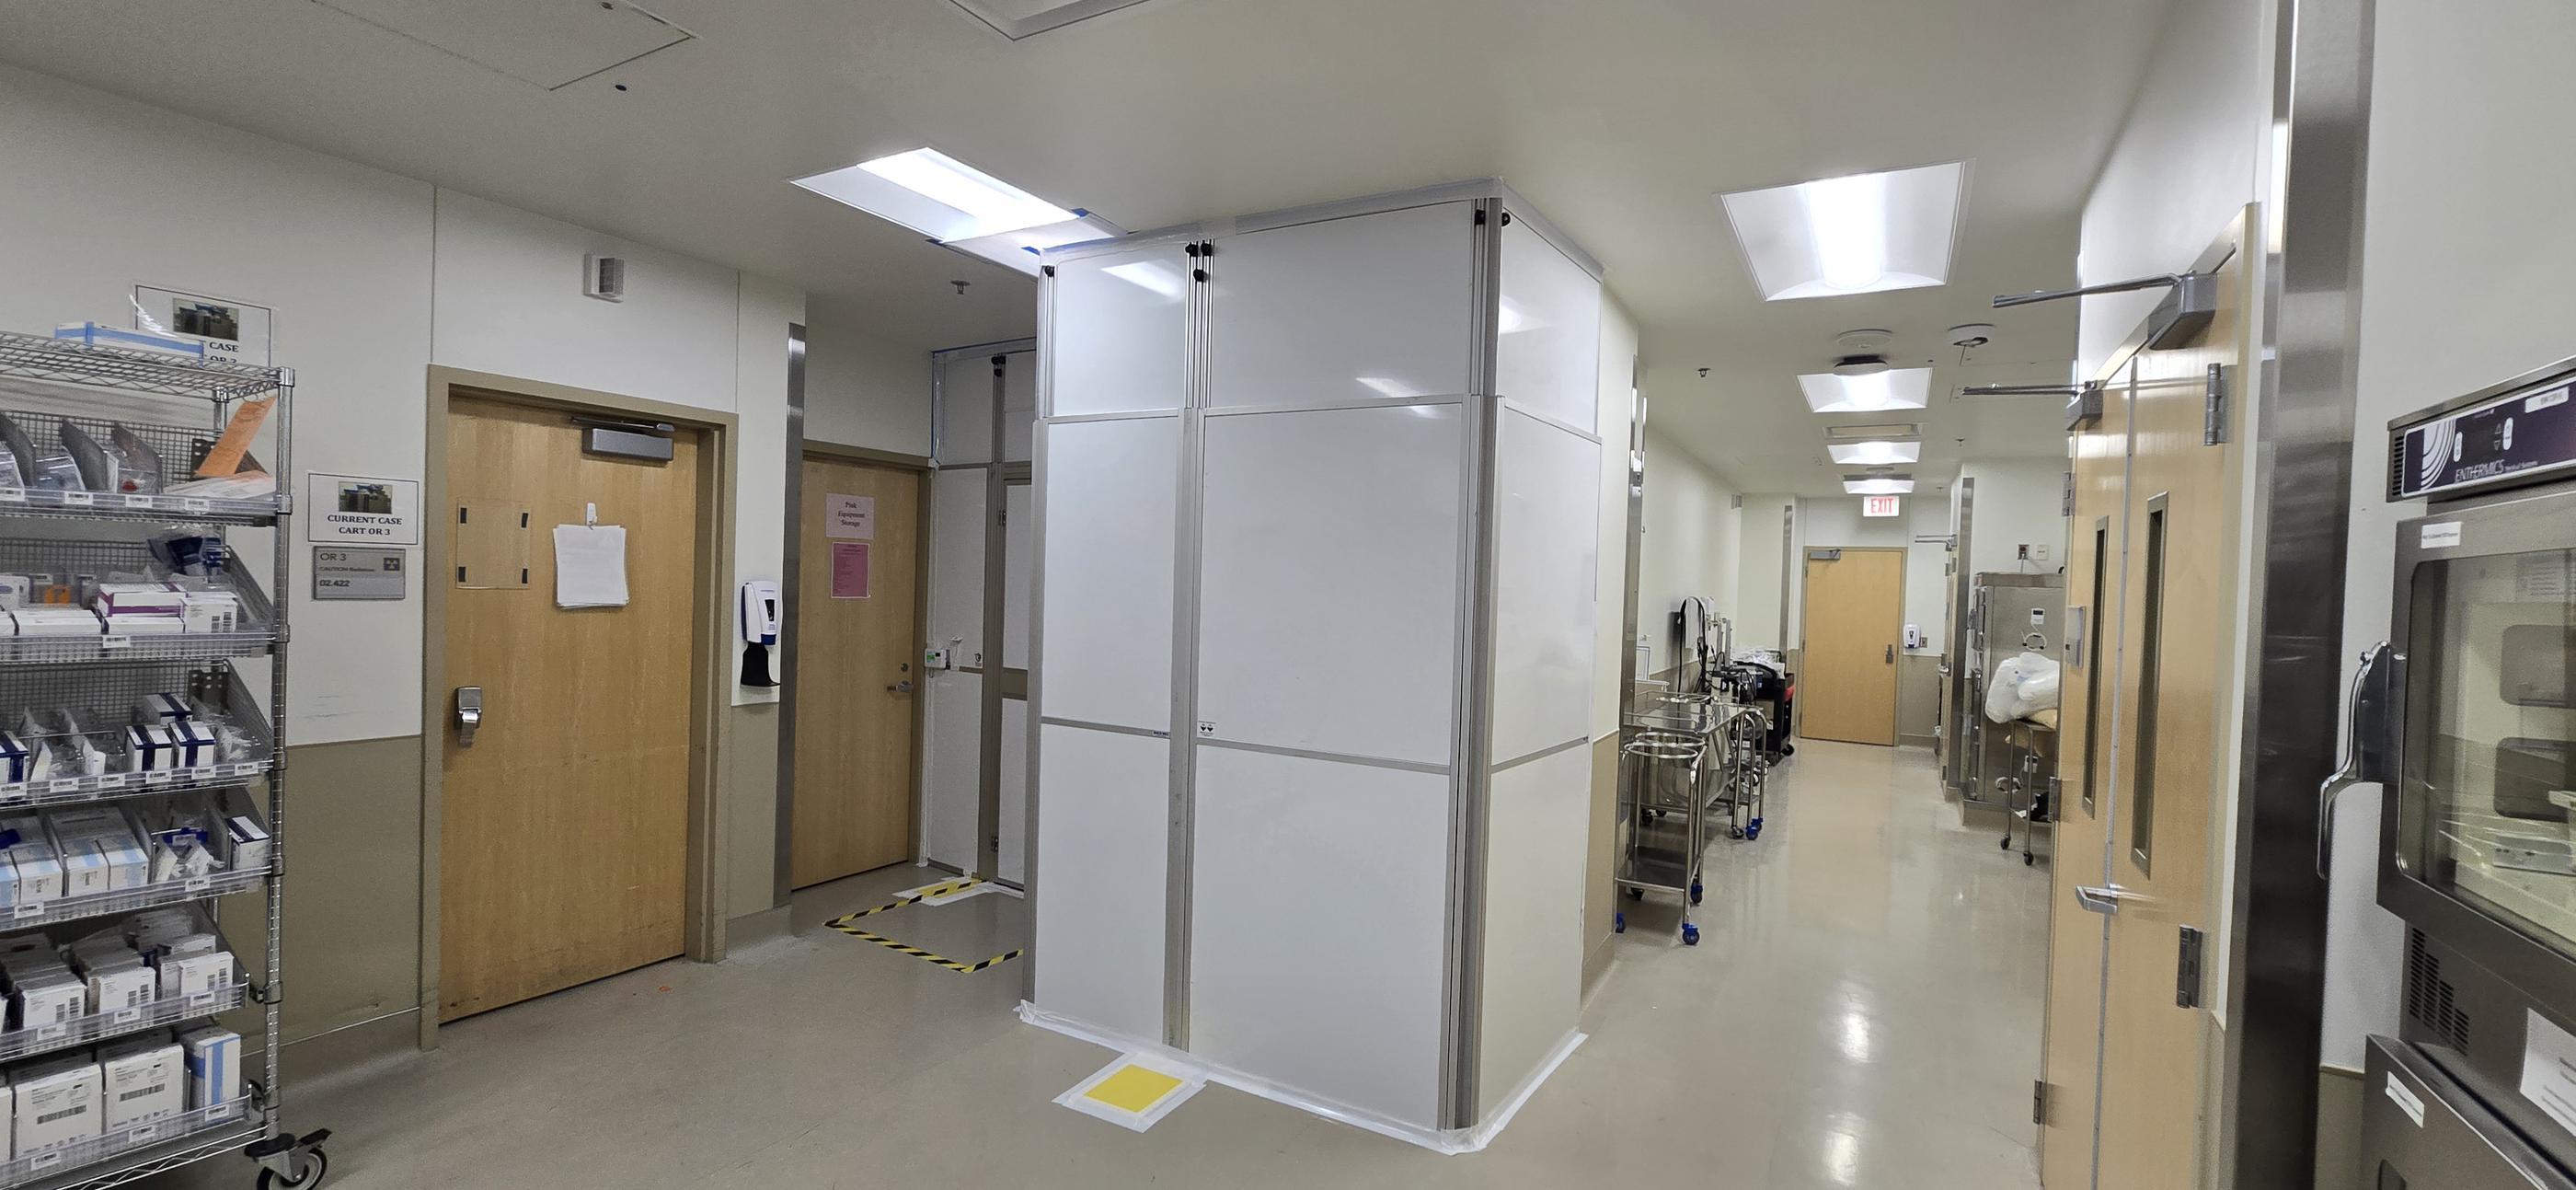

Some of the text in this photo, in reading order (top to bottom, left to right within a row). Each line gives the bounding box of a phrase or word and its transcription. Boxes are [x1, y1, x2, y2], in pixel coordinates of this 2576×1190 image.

[209, 341, 239, 352] CASE
[2455, 459, 2504, 482] ENTHERMICS
[1870, 498, 1893, 514] EXIT
[328, 514, 402, 526] CURRENT CASE
[339, 526, 366, 535] CART
[320, 552, 347, 561] OR 3
